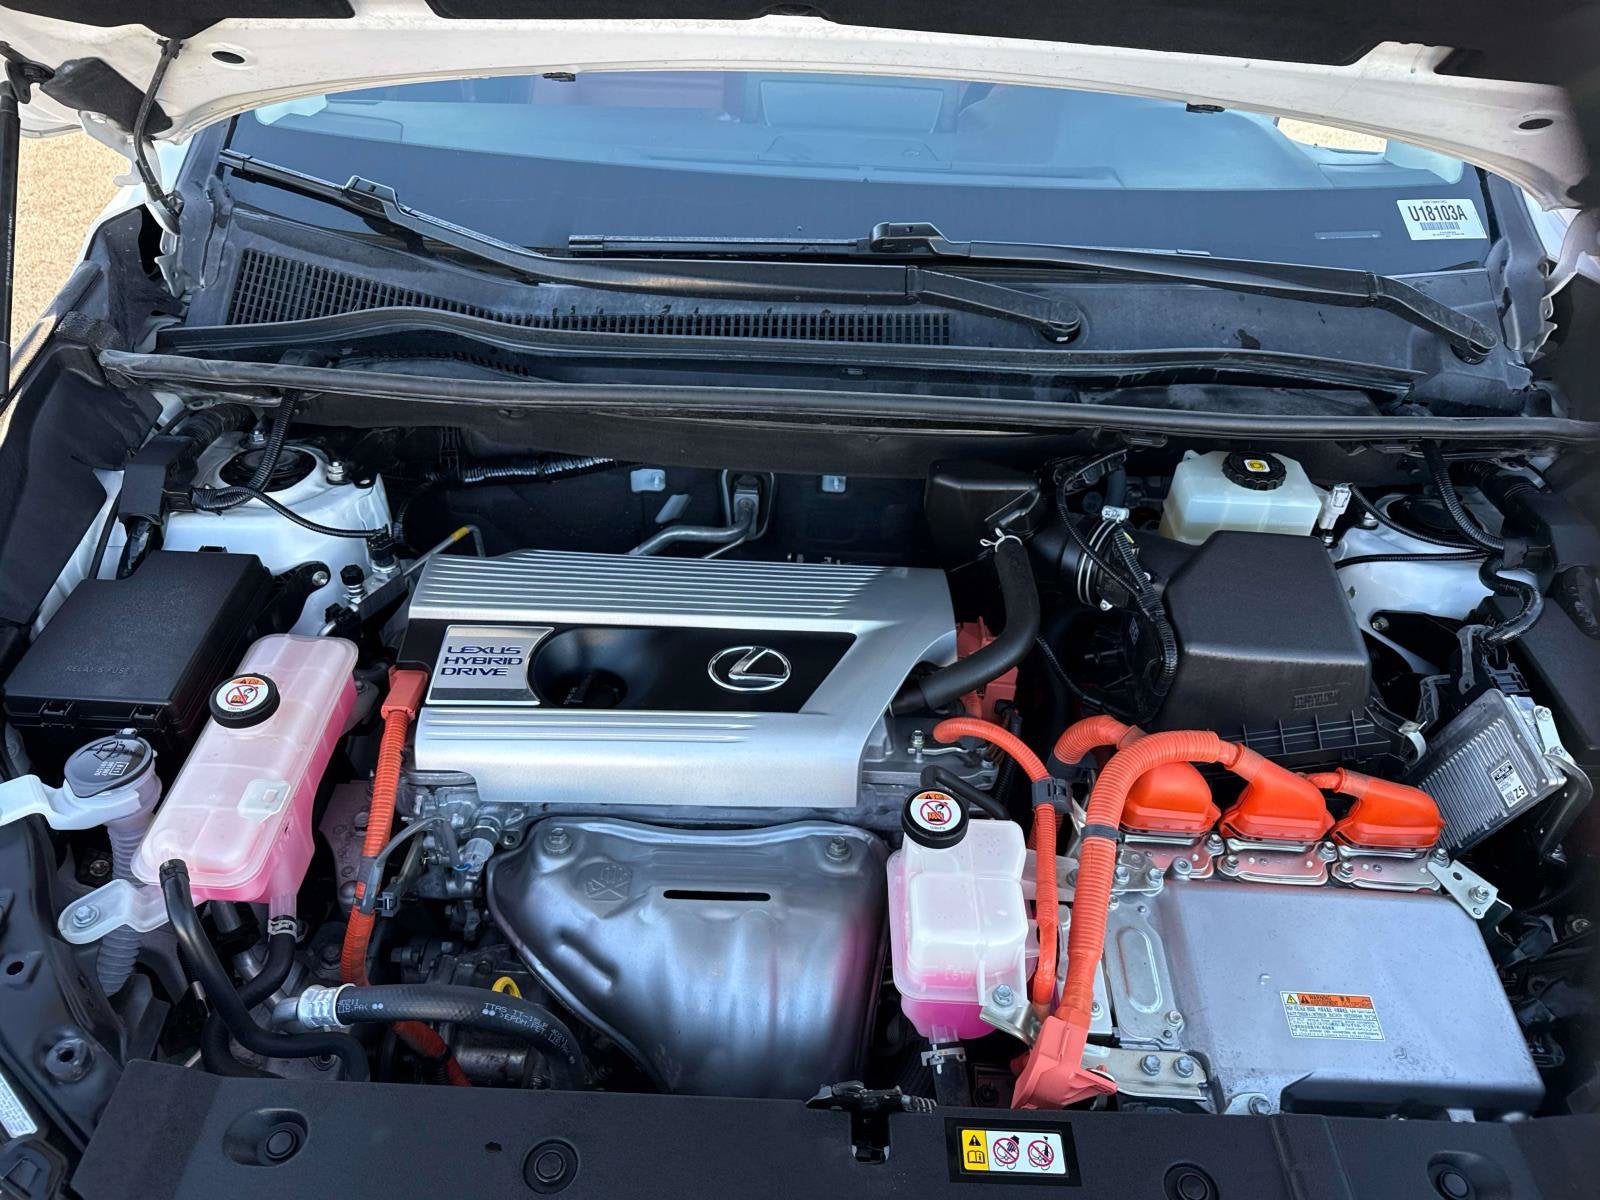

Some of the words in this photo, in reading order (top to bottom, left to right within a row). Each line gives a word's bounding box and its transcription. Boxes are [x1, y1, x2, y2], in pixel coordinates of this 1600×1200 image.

[1407, 204, 1469, 222] U18103A
[447, 645, 521, 655] LEXUS
[443, 656, 523, 666] HYBRID
[440, 667, 509, 676] DRIVE
